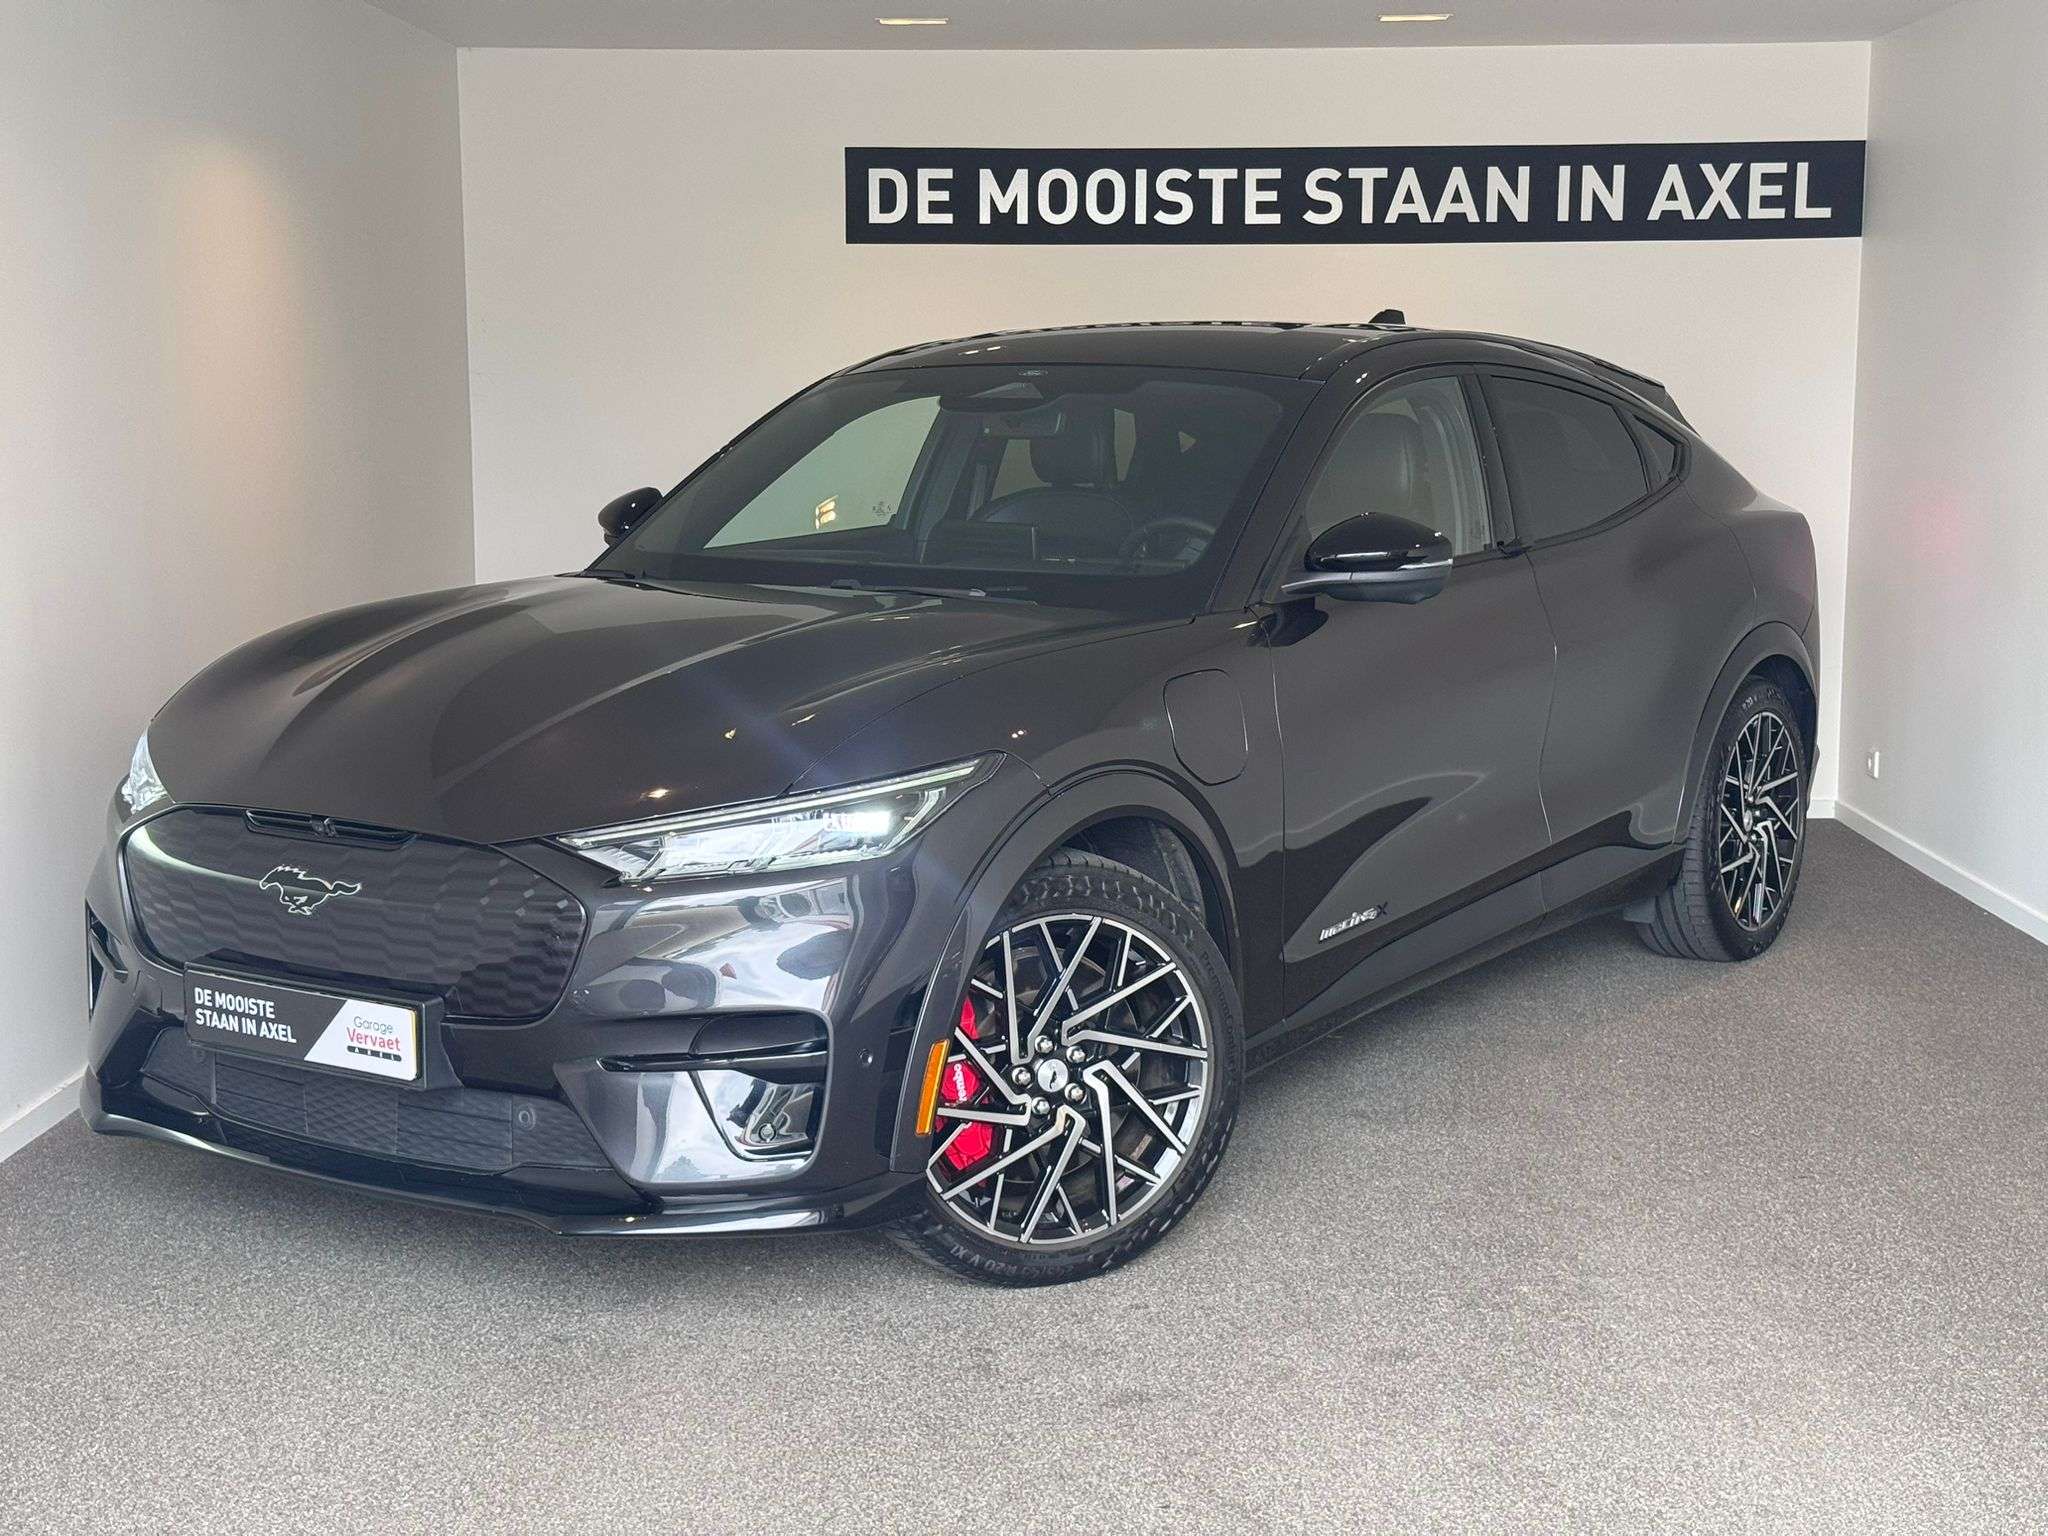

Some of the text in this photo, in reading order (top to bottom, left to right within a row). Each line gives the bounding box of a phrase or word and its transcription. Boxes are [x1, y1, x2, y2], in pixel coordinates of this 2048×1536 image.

[868, 161, 1832, 225] DE MOOISTE STAAN IN AXEL
[194, 987, 276, 1019] DE MOOISTE
[195, 1008, 297, 1043] STAAN IN AXEL
[346, 1026, 401, 1052] Vervaet
[353, 1016, 393, 1035] Garage
[953, 1063, 968, 1102] rembo
